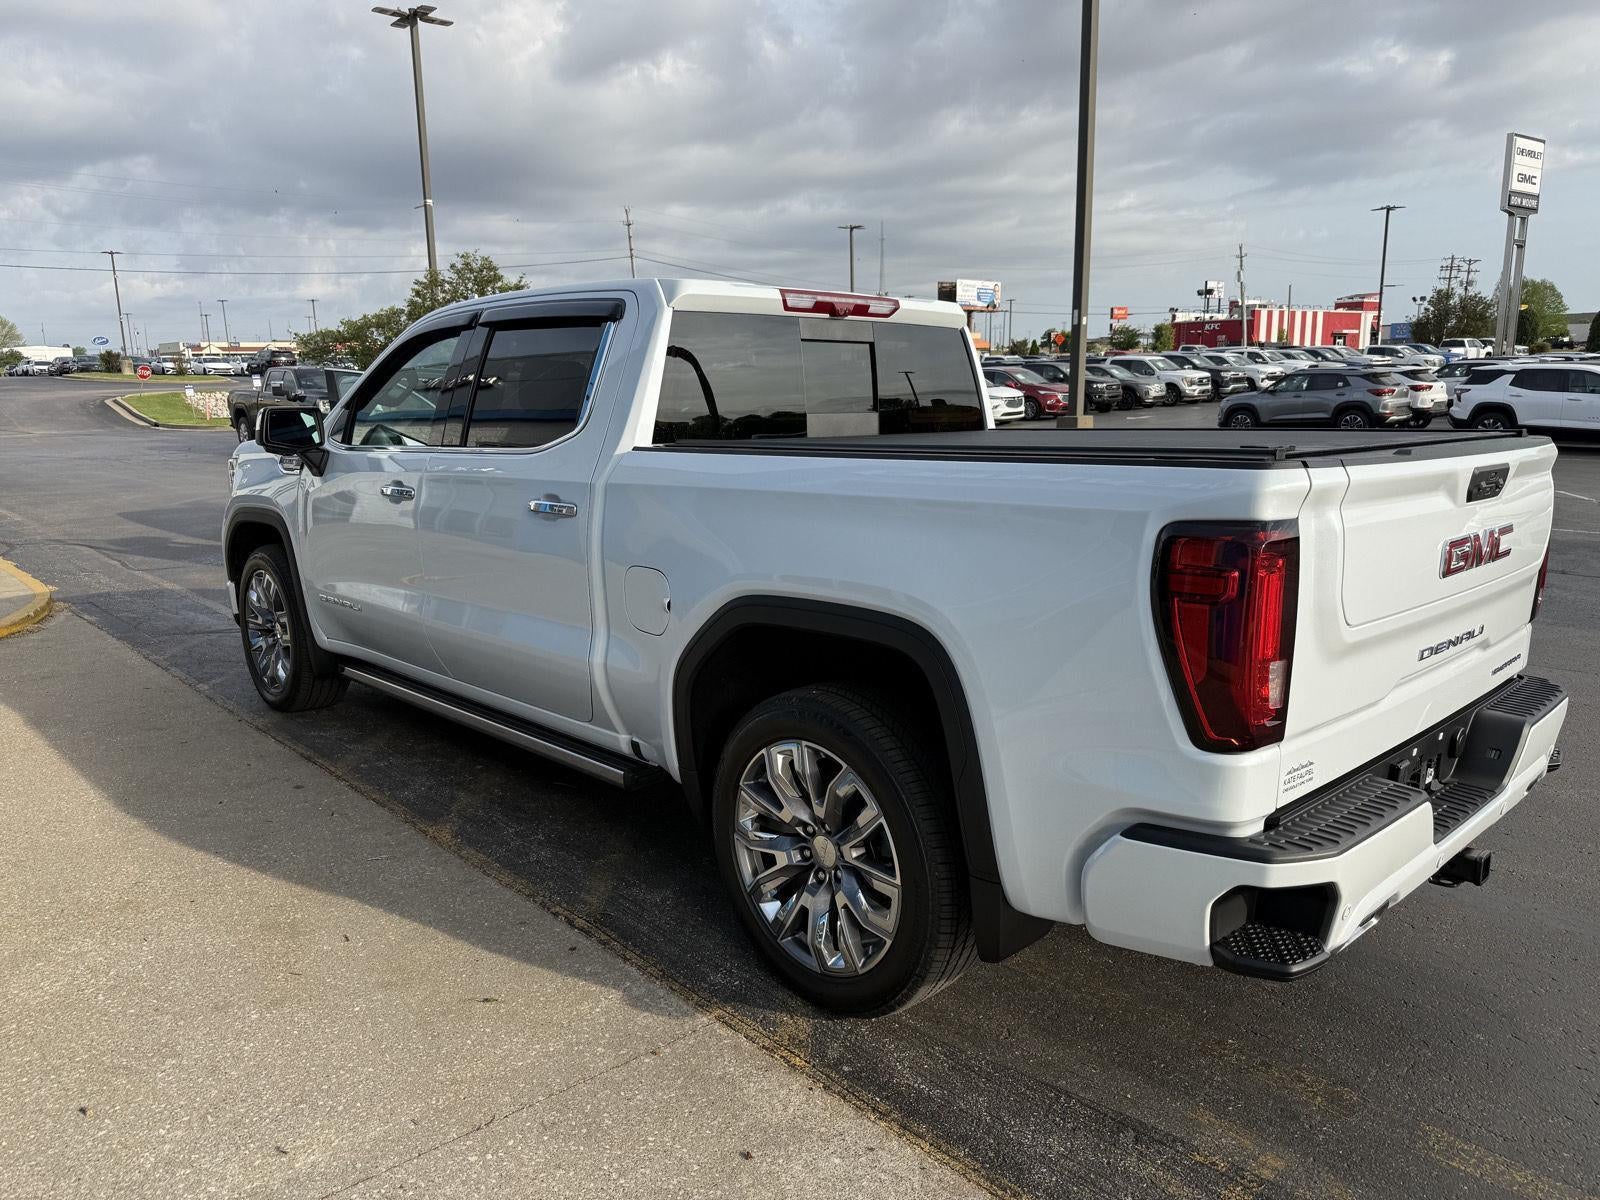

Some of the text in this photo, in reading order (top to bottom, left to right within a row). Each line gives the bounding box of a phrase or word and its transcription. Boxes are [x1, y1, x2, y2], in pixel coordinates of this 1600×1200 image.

[1516, 147, 1542, 160] CHEVROLET
[1517, 173, 1537, 185] GMC
[1439, 522, 1514, 579] GMC
[319, 593, 361, 611] DENALI
[1418, 624, 1484, 662] DENALI
